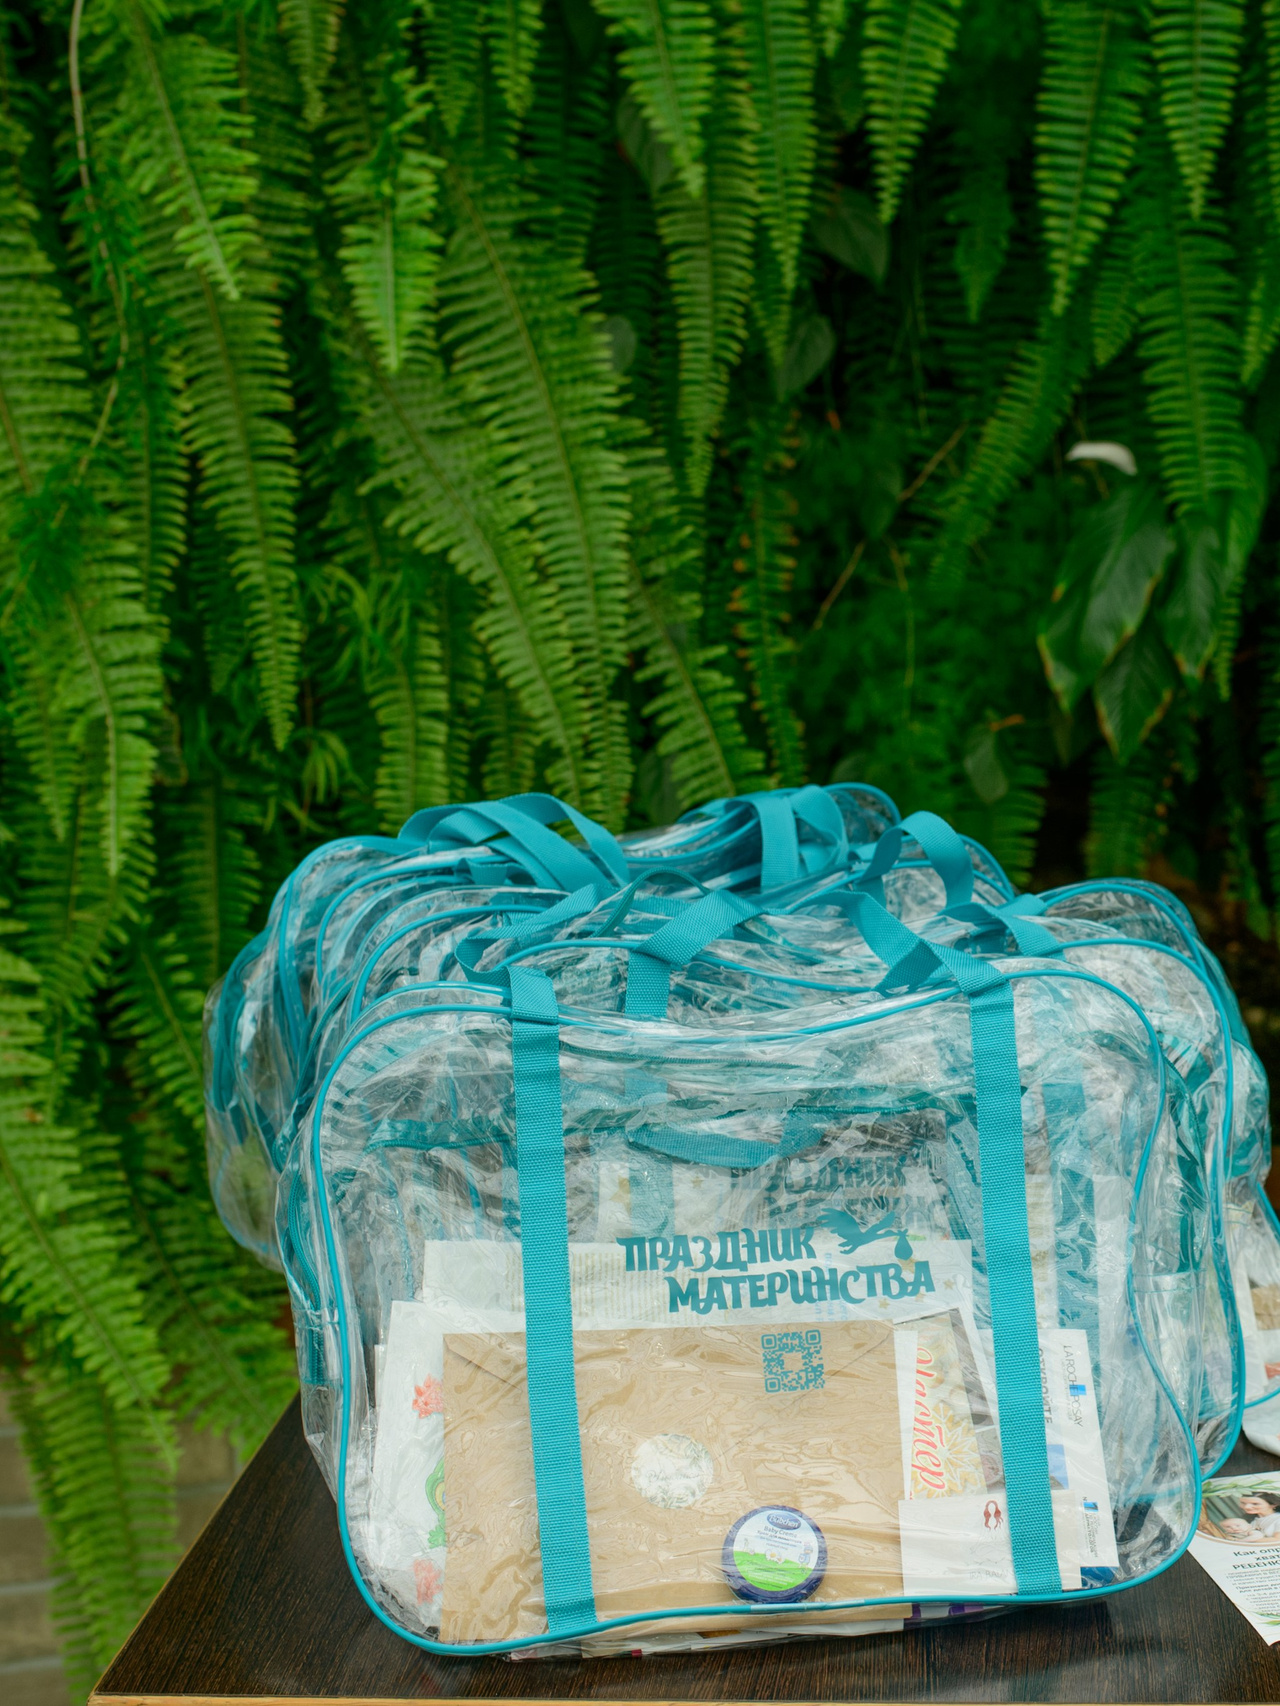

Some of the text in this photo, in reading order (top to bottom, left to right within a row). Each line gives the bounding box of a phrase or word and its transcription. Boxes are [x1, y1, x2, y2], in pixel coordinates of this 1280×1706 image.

[616, 1226, 818, 1273] ПРАЗДНИК
[664, 1260, 936, 1315] МАТЕРИНСТВА
[1232, 1548, 1257, 1557] Как
